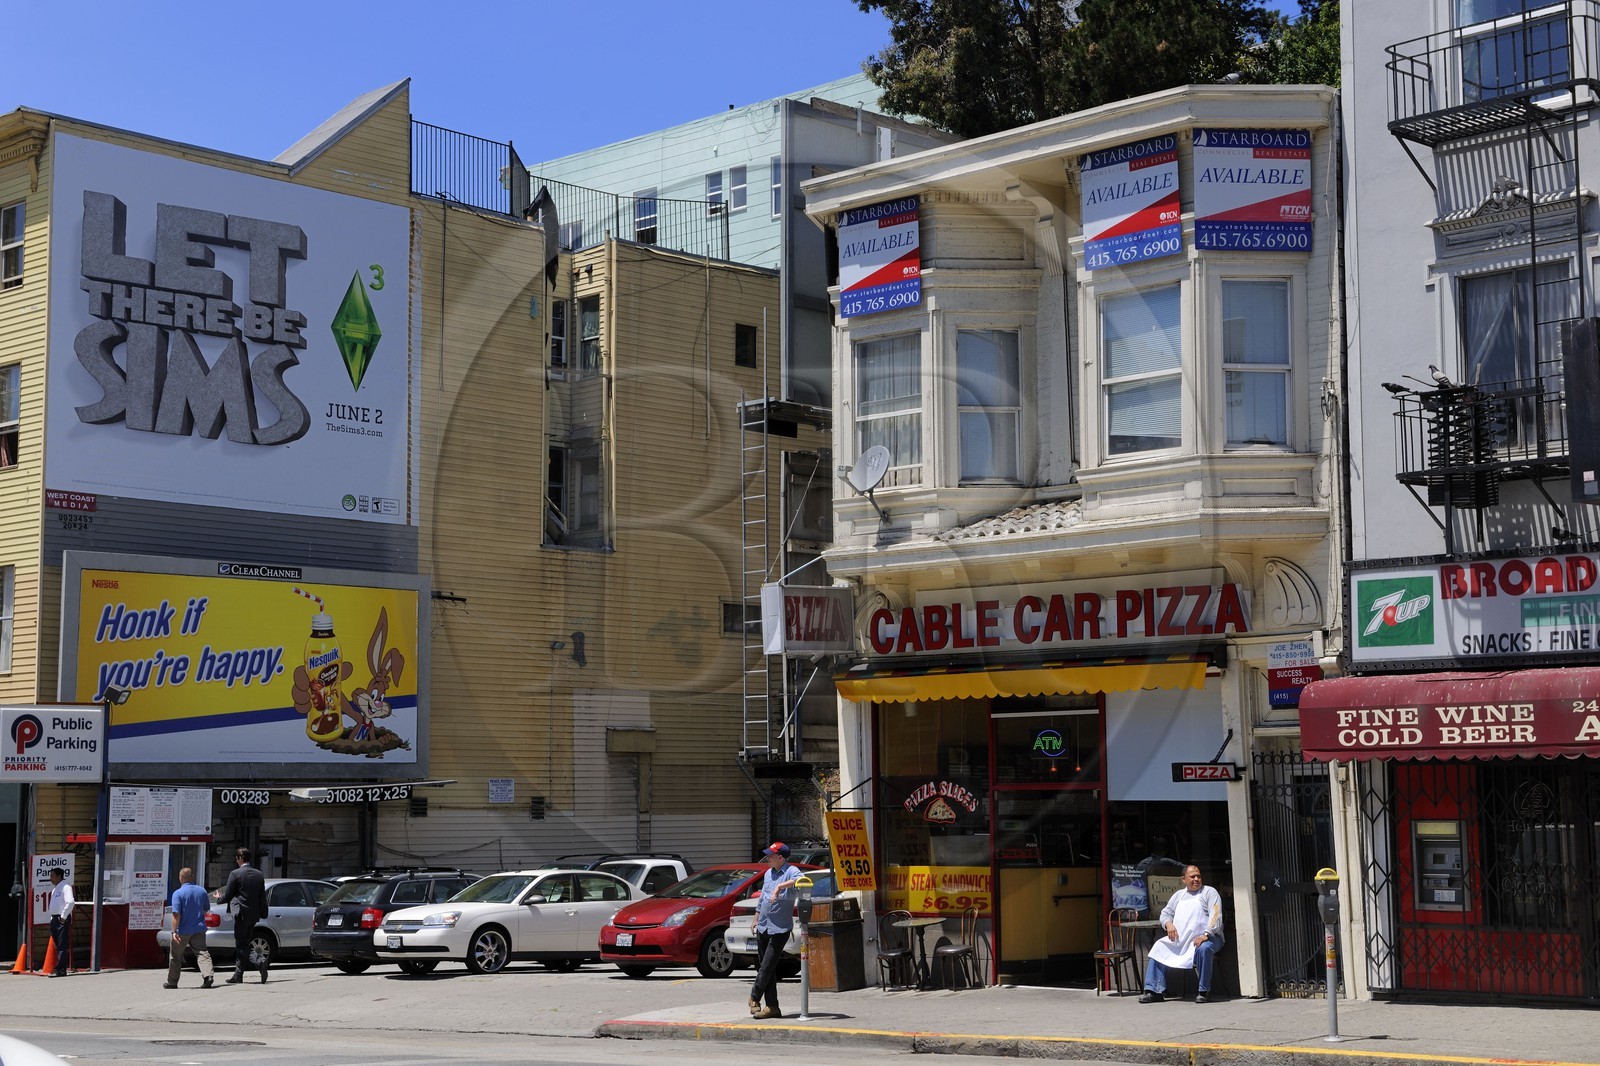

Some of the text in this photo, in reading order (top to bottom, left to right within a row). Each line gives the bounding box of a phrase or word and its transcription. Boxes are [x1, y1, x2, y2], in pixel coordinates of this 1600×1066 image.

[1211, 131, 1307, 146] STARBOARD
[1094, 136, 1174, 167] STARBOARD
[1131, 154, 1175, 169] REAL ESTATE
[1199, 167, 1304, 185] AVAILABLE
[1086, 172, 1173, 206] AVAILABLE
[850, 198, 916, 223] STARBOARD
[1200, 223, 1306, 231] www.starboardnet.com
[842, 230, 915, 259] AVAILABLE
[1088, 227, 1178, 250] www.starboardnet.com
[1199, 232, 1308, 248] 415.765.6900
[81, 189, 308, 309] LET
[1087, 237, 1180, 267] 415.765.6900
[369, 263, 385, 291] 3
[843, 280, 919, 299] www.starboardnet.com
[843, 290, 920, 315] 415.765.6900
[80, 278, 308, 350] THERE BE
[74, 318, 311, 446] SIMS
[326, 402, 383, 425] JUNE 2
[326, 422, 383, 438] TheSims3.com
[54, 500, 89, 510] MEDIA
[70, 494, 96, 503] COAST
[95, 597, 209, 643] Honk if
[784, 595, 849, 642] PIZZA
[870, 583, 1249, 655] CABLE CAR PIZZA
[1363, 588, 1431, 636] 7UP
[1274, 643, 1308, 652] JOE ZHEN
[1462, 632, 1532, 654] SNACKS
[1550, 629, 1590, 651] FINE
[309, 648, 339, 670] Nesquik
[1284, 659, 1297, 667] FOR
[1299, 658, 1316, 666] SALE
[93, 646, 285, 702] you're happy.
[1276, 669, 1303, 678] SUCCESS
[1291, 677, 1313, 685] REALTY
[1273, 692, 1289, 701] (415)
[1572, 699, 1600, 713] 24
[1337, 703, 1535, 727] FINE WINE
[52, 717, 93, 731] Public
[1338, 724, 1537, 746] COLD BEER
[46, 736, 97, 753] Parking
[4, 763, 47, 772] PARKING
[1183, 766, 1232, 779] PIZZA
[221, 789, 270, 805] 003283
[903, 781, 937, 814] PIZZA
[832, 818, 864, 831] SLICE
[843, 833, 857, 841] ANY
[836, 844, 868, 857] PIZZA
[39, 857, 68, 867] Public
[840, 859, 871, 876] $3.50
[36, 868, 71, 878] Parg
[843, 877, 873, 888] FREE COKE
[911, 873, 938, 891] STEAK
[942, 873, 991, 893] SANDWICH
[35, 890, 52, 913] $1
[922, 895, 989, 911] $6.95
